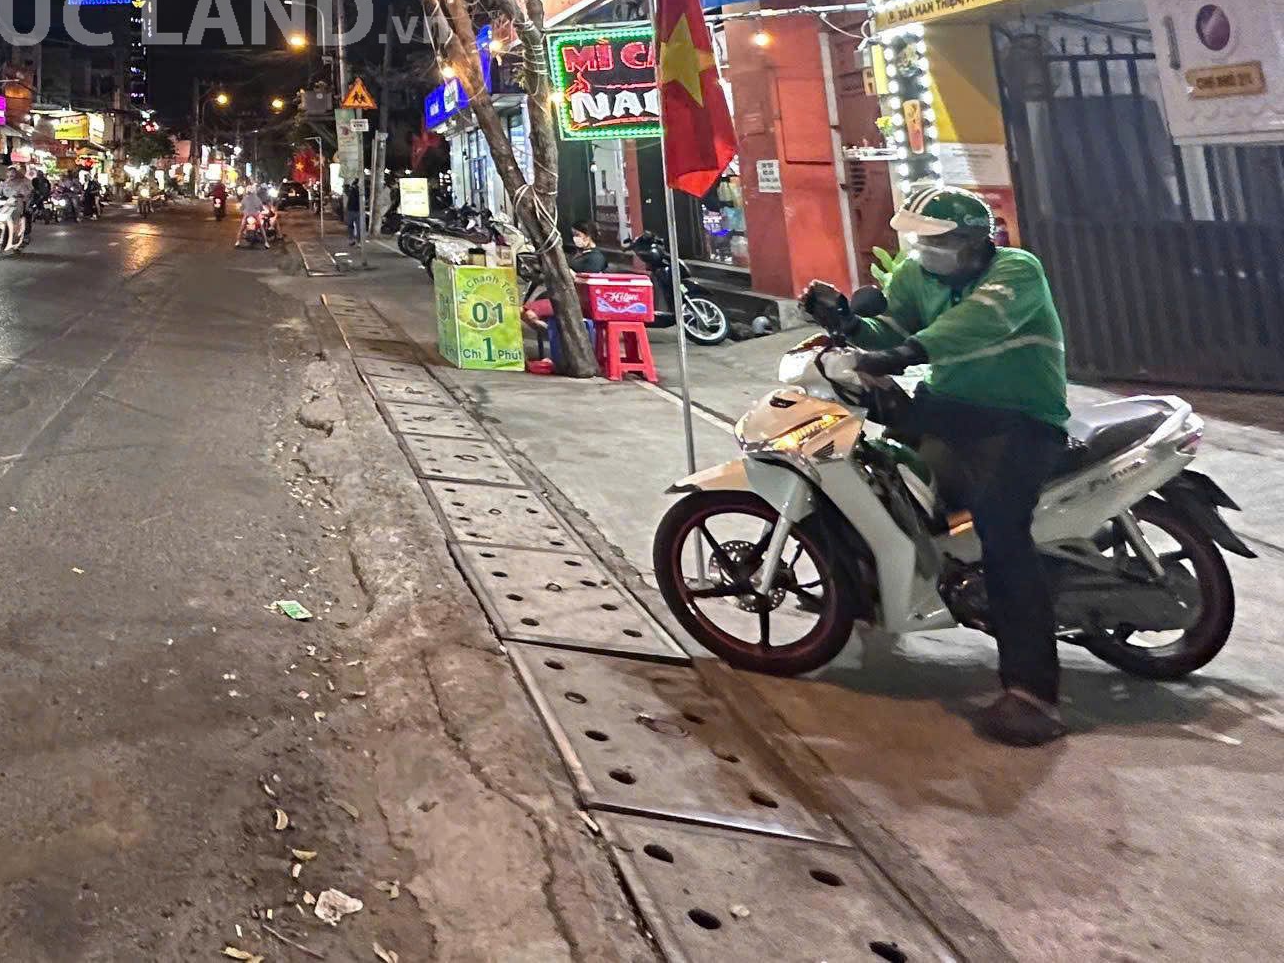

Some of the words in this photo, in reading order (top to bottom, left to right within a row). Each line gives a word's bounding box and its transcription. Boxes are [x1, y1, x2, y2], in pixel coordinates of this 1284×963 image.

[915, 1, 934, 17] MAN
[561, 37, 614, 73] MÌ
[472, 302, 504, 324] 01
[482, 336, 497, 363] 1
